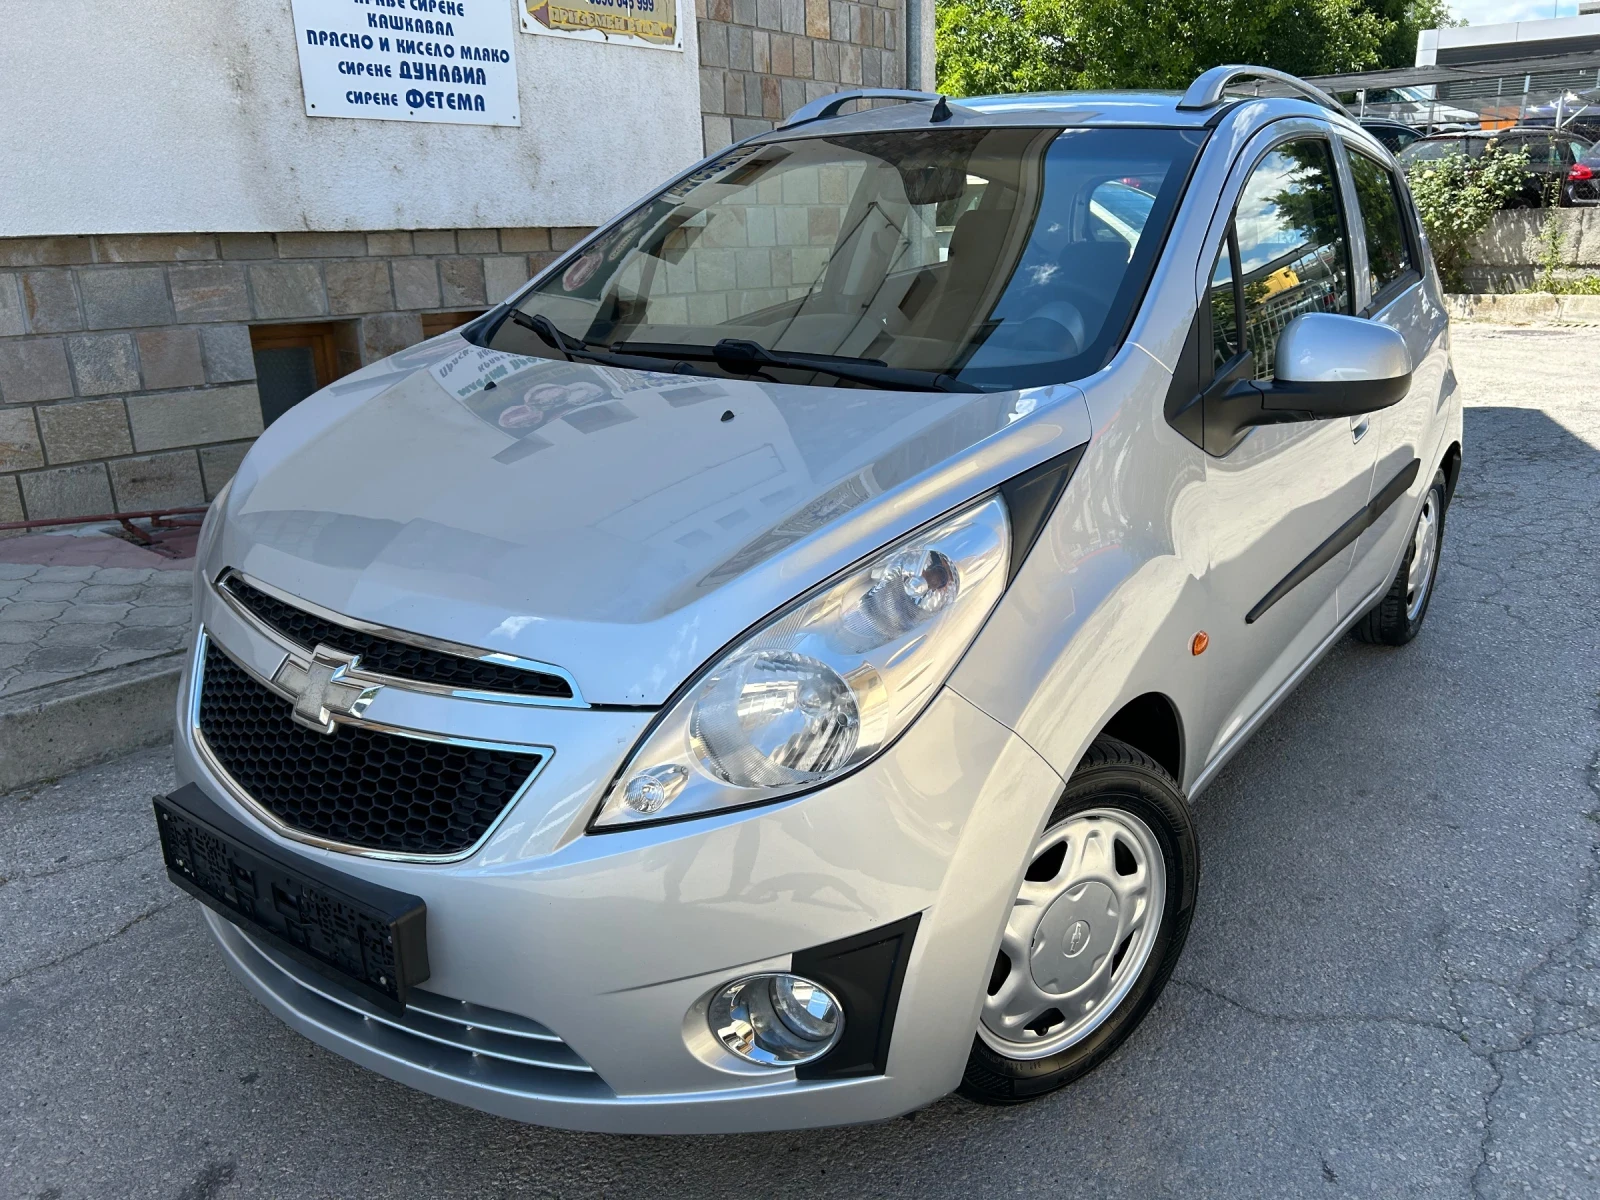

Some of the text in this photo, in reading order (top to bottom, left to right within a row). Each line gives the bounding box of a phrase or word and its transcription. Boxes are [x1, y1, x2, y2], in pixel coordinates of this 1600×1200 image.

[409, 0, 465, 17] СИРЕНЕ
[367, 12, 455, 37] КАШКАВАЛ
[306, 29, 510, 63] ПРЯСНО И КИСЕЛО МЛЯКО
[338, 60, 487, 86] СИРЕНЕ ДУНАВИЯ
[346, 88, 486, 112] СИРЕНЕ ФЕТЕМА
